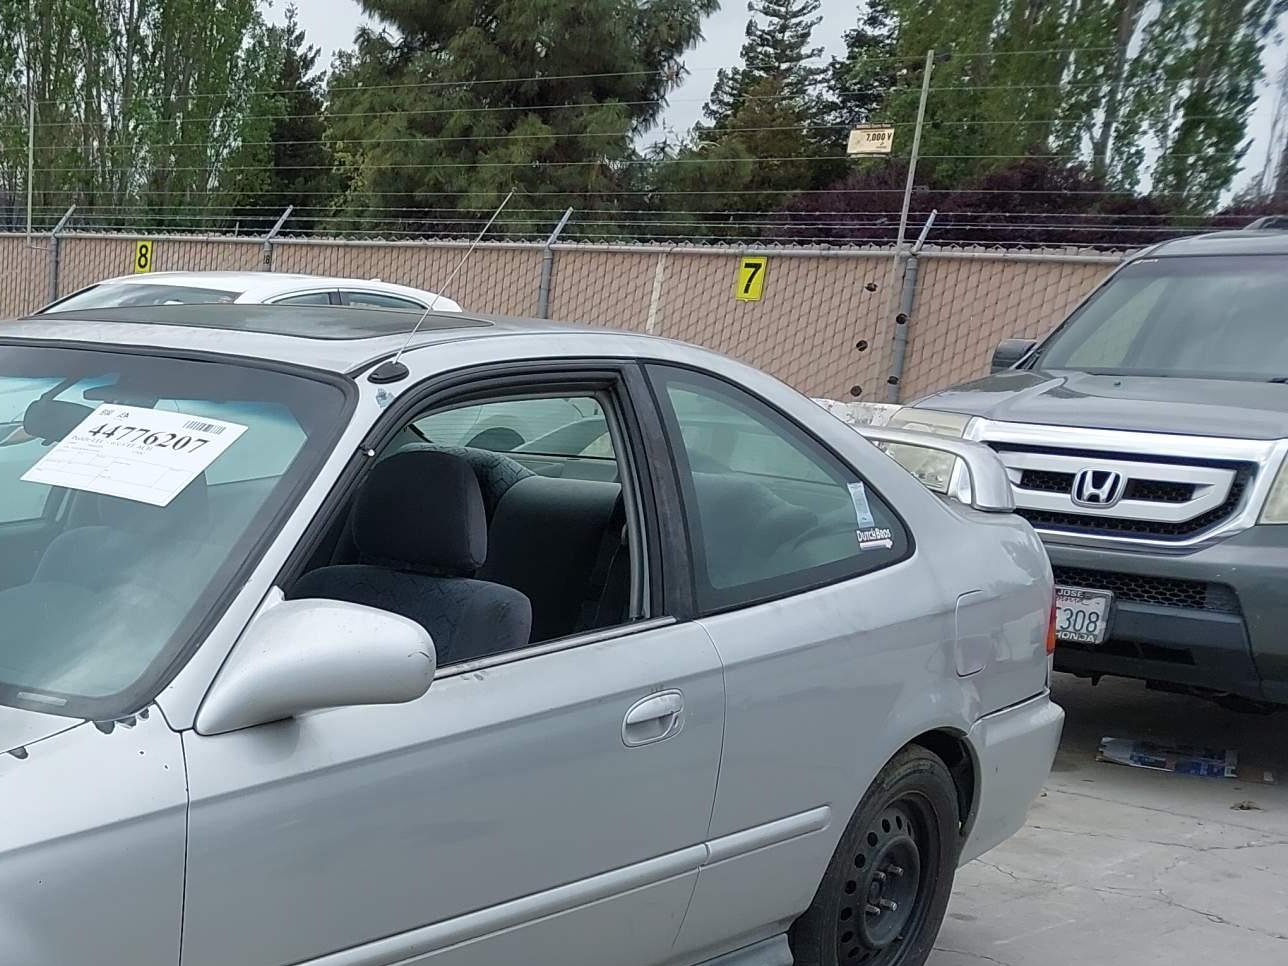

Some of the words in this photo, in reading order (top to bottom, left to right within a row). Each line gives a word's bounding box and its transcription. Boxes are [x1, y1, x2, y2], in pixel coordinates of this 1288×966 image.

[137, 244, 150, 269] 8
[743, 262, 763, 294] 7
[88, 422, 210, 454] 44776207
[1057, 588, 1084, 598] JOSE
